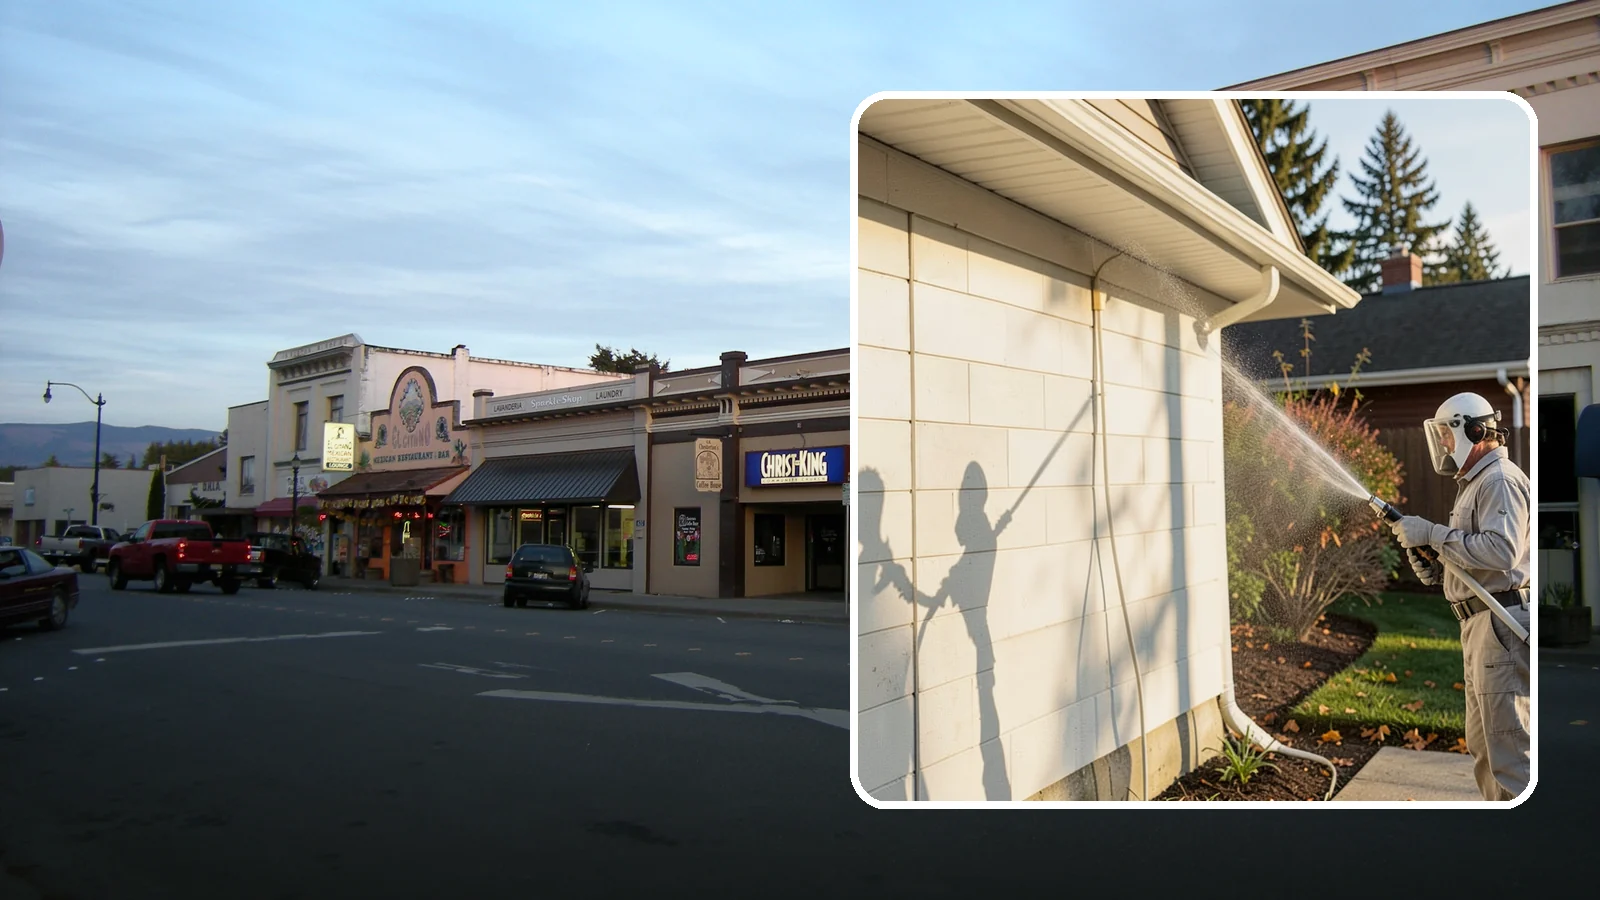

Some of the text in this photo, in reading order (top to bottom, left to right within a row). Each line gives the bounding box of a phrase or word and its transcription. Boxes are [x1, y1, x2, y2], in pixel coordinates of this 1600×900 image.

[493, 389, 624, 413] LAVANDERIA Sparkle Shop LAUNDRY
[374, 454, 396, 464] MEXICAN
[397, 451, 433, 462] RESTAURANT
[438, 450, 450, 459] BAR
[761, 450, 827, 478] CHRIST KING
